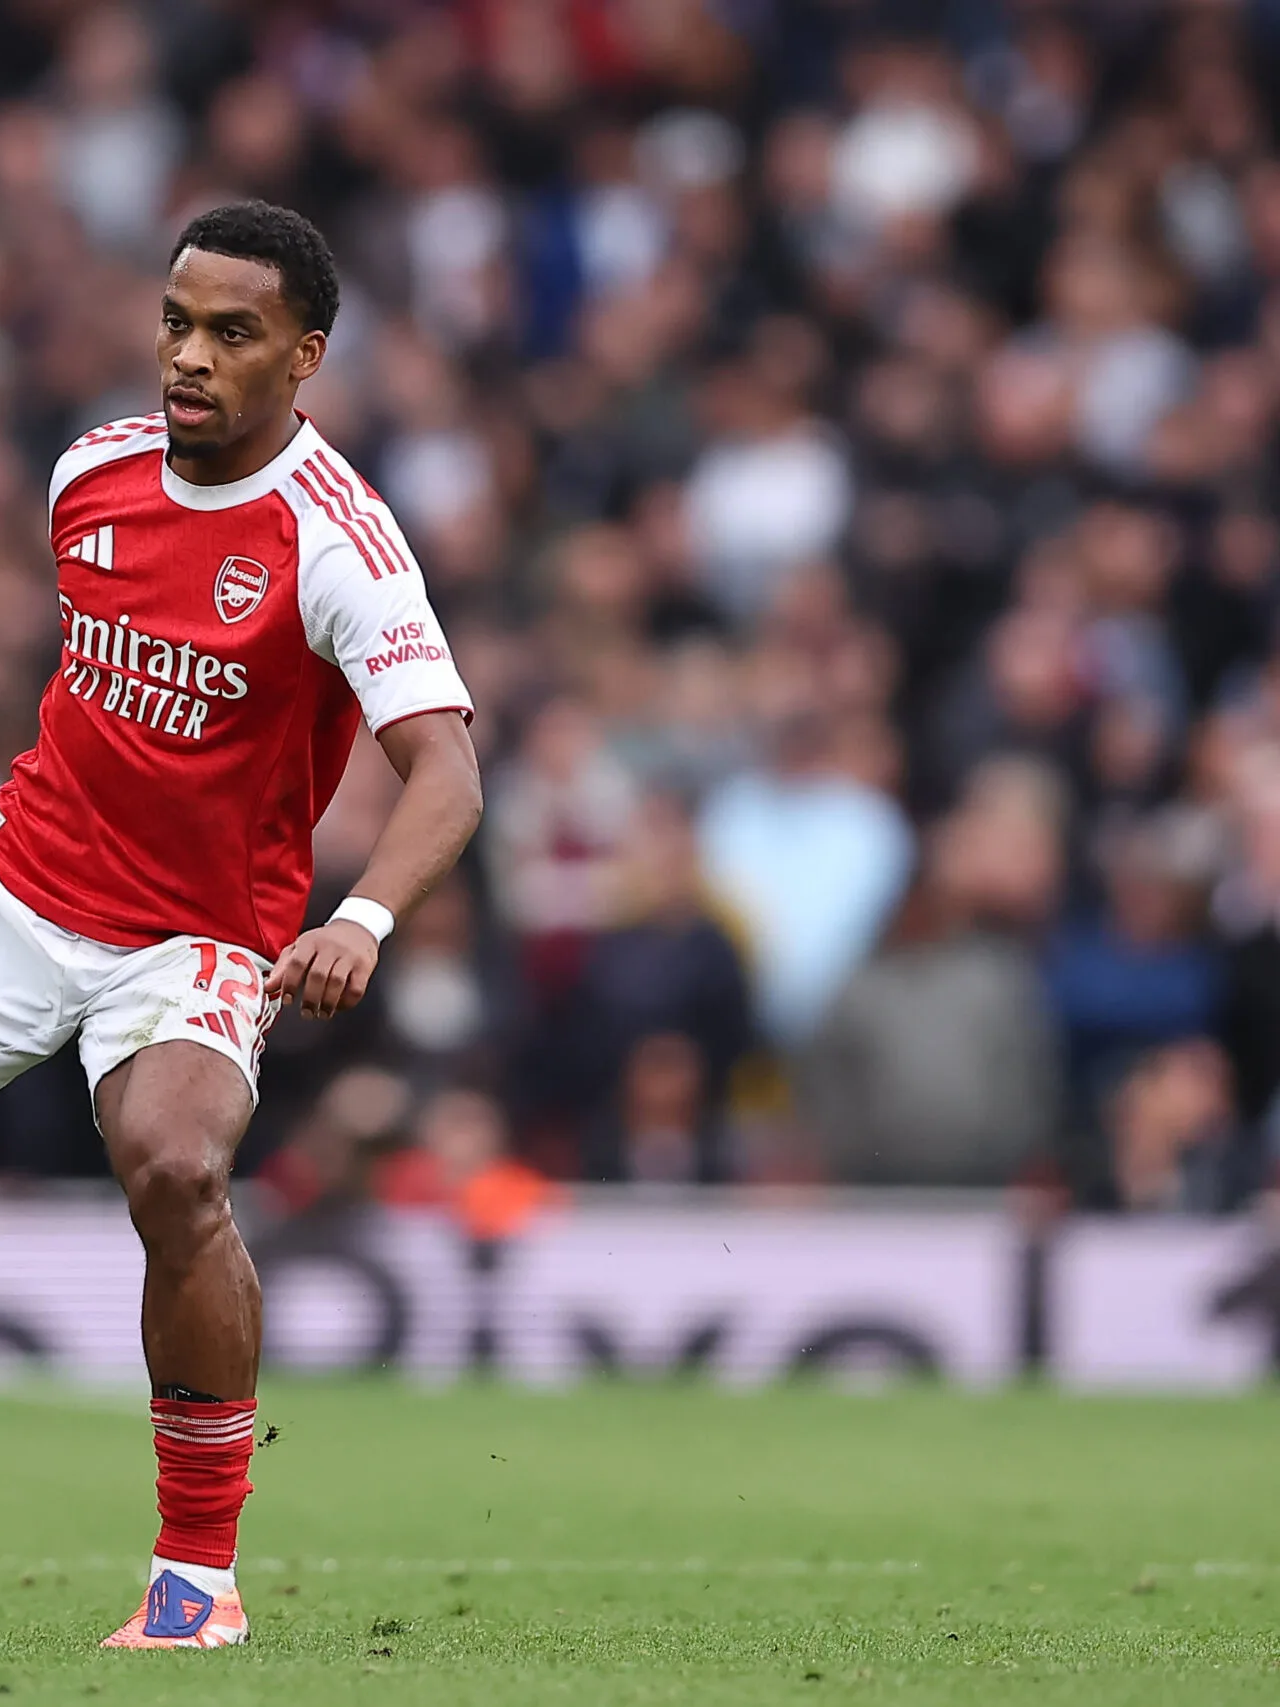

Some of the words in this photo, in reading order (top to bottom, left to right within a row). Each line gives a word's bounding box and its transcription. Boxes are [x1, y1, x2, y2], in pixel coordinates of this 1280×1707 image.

[227, 565, 264, 587] Arsenal
[381, 621, 426, 646] VISI
[102, 671, 209, 740] BETTER
[189, 943, 259, 1028] 12
